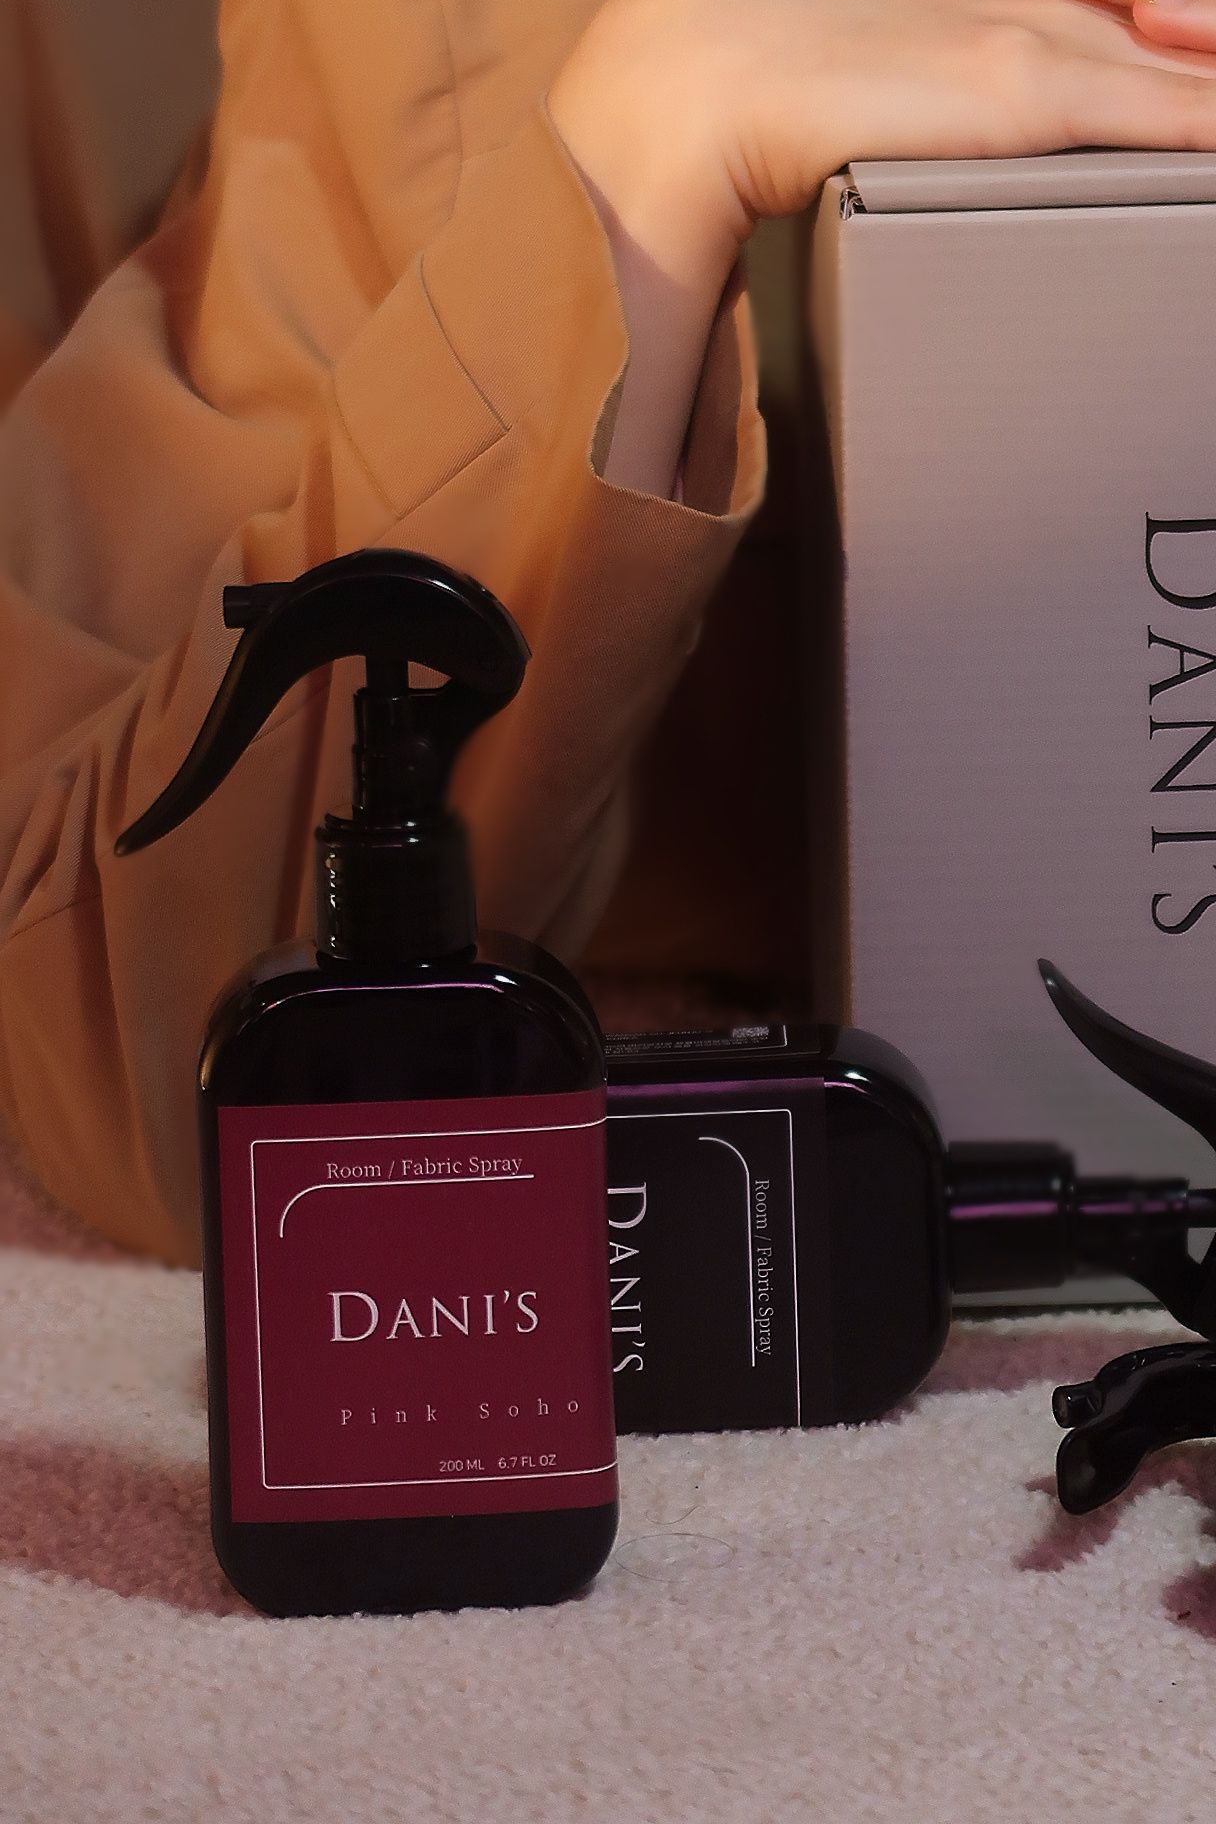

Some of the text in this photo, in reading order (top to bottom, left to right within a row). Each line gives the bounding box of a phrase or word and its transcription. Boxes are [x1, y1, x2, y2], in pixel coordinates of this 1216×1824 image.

[327, 1157, 523, 1179] Room / Fabric Spray
[755, 1180, 769, 1229] Room
[607, 1181, 648, 1373] DANI'S
[757, 1247, 774, 1302] Fabric
[327, 1290, 539, 1342] DANI'S
[755, 1307, 774, 1356] Spray
[340, 1398, 579, 1425] Pink Soho
[439, 1454, 557, 1472] 200 ML 6.7 FL OZ
